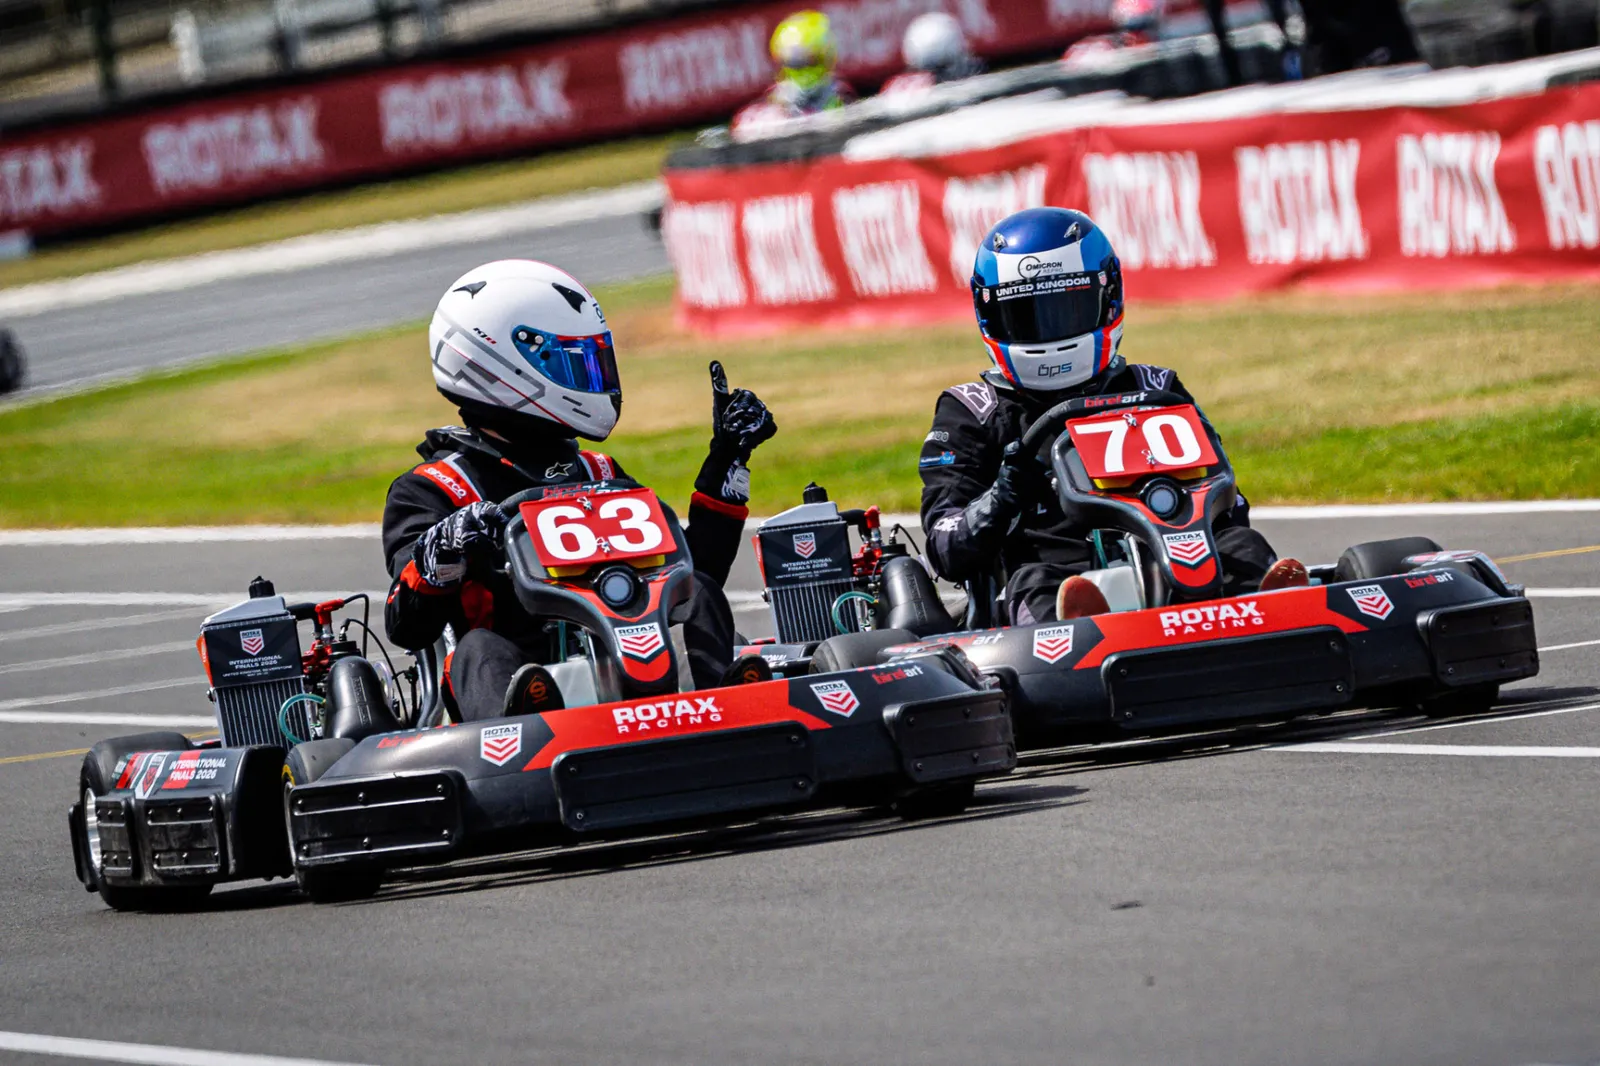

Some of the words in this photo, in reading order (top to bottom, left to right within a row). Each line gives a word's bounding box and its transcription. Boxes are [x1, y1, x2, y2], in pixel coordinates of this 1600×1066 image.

[1235, 139, 1369, 265] ROTAX
[1397, 131, 1516, 258] ROTAX
[995, 284, 1034, 297] UNITED
[1036, 276, 1091, 290] KINGDOM
[1084, 391, 1148, 408] birelart
[1074, 414, 1202, 473] 70
[536, 497, 663, 560] 63
[1166, 532, 1202, 541] ROTAX
[782, 557, 832, 568] INTERNATIONAL
[1404, 572, 1454, 589] birelart
[1350, 586, 1381, 596] ROTAX
[1159, 601, 1261, 629] ROTAX
[618, 625, 656, 634] ROTAX
[1037, 628, 1070, 637] ROTAX
[1163, 617, 1264, 637] RACING
[228, 654, 282, 666] INTERNATIONAL
[235, 662, 259, 670] FINALS
[814, 683, 845, 692] ROTAX
[612, 696, 720, 725] ROTAX
[484, 726, 519, 736] ROTAX
[617, 713, 722, 734] RACING
[168, 758, 227, 771] INTERNATIONAL
[169, 770, 195, 781] FINALS
[195, 769, 218, 780] 2026
